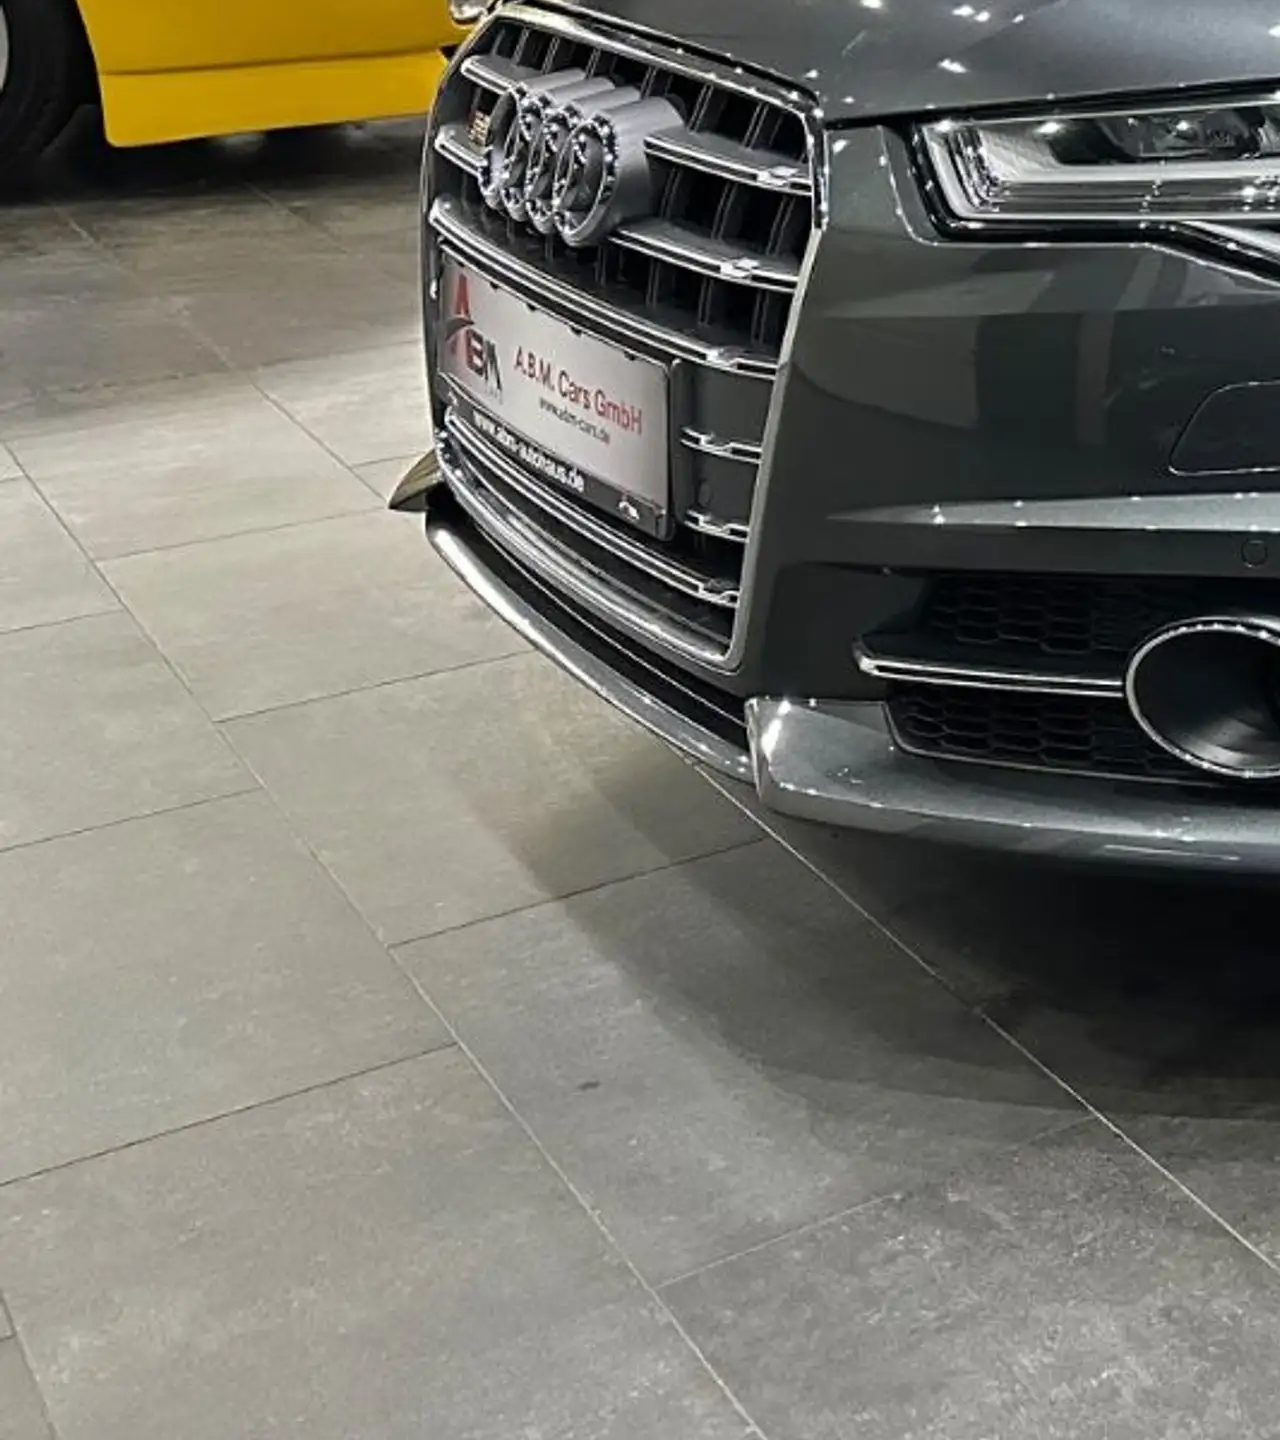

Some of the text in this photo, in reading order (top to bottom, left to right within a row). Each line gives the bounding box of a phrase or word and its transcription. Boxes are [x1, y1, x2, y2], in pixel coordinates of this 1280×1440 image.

[513, 345, 643, 436] A.B.M. Cars GmbH
